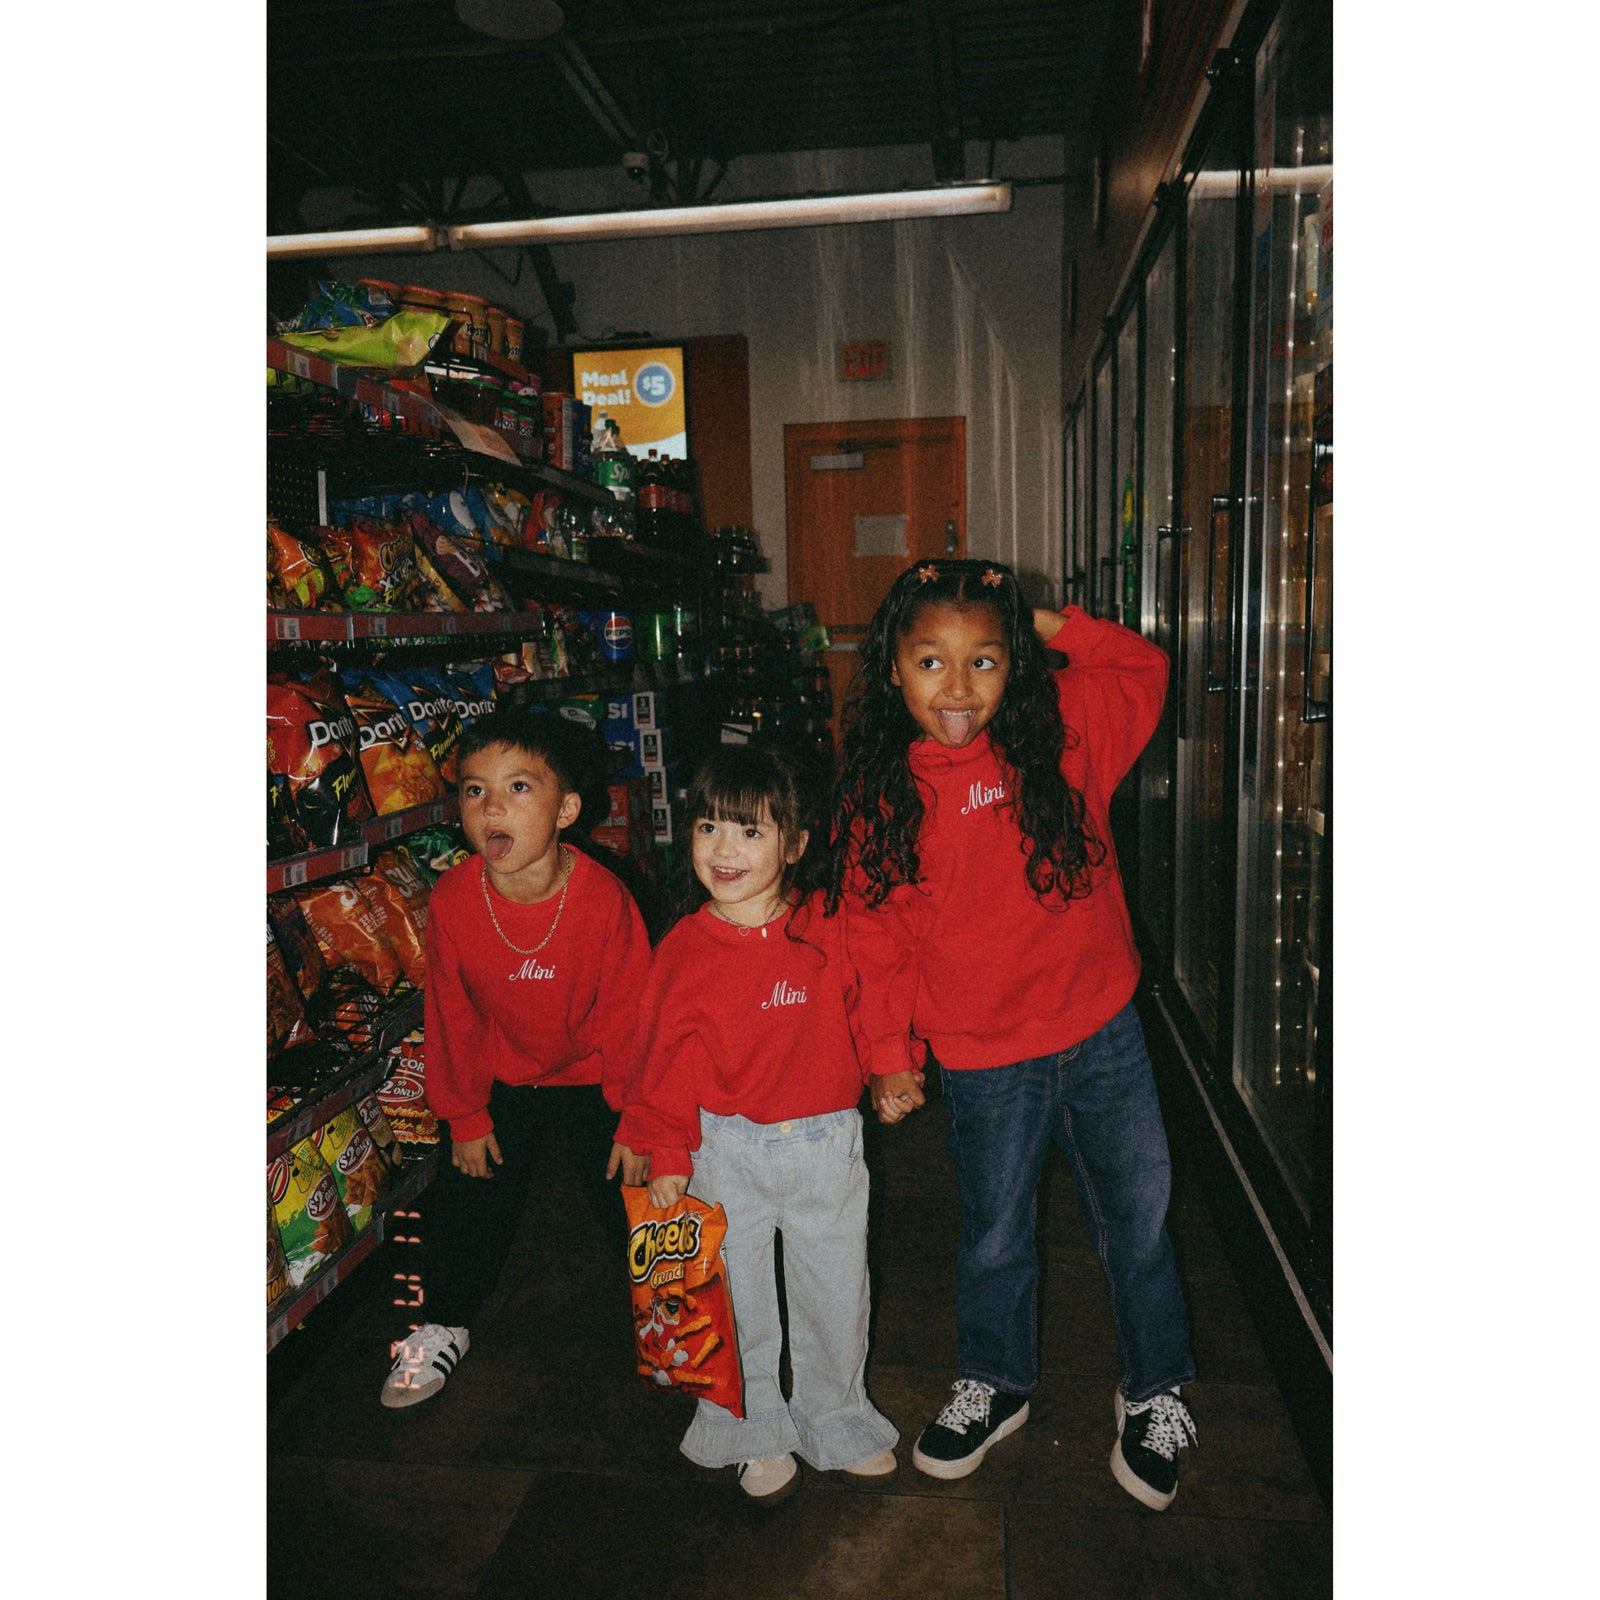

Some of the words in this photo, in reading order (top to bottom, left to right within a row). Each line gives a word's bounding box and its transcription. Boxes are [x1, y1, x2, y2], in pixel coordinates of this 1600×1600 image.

[844, 344, 884, 377] EXIT
[581, 369, 628, 388] Meal
[642, 375, 666, 396] $5
[582, 389, 631, 407] Deal!
[960, 780, 1005, 815] Mini
[508, 958, 556, 981] Mini
[761, 979, 807, 1010] Mini
